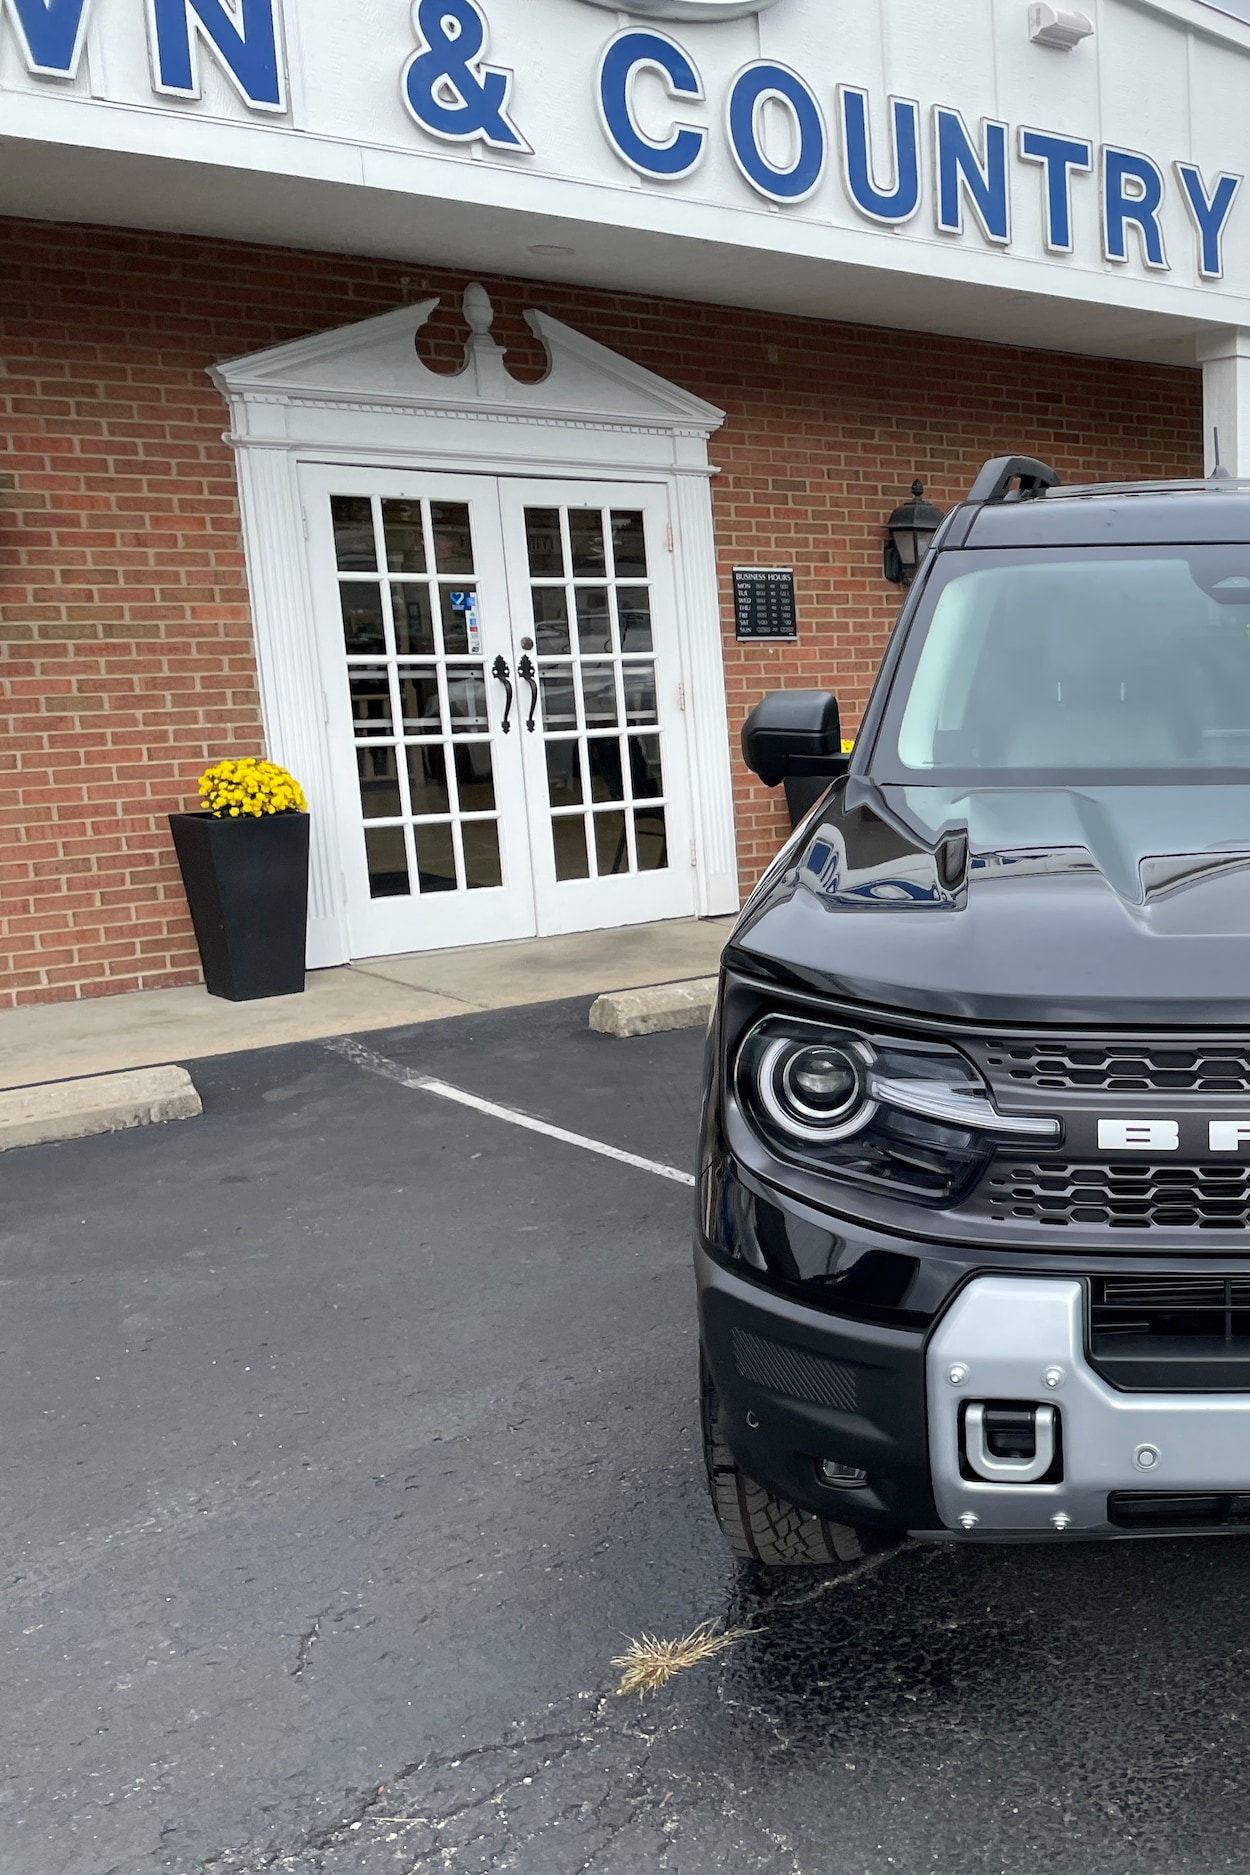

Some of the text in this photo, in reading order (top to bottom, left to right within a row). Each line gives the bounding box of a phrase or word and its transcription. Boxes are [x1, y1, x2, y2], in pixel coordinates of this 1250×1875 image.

[401, 0, 536, 156] &
[598, 25, 1244, 280] COUNTRY
[768, 573, 791, 581] HOURS
